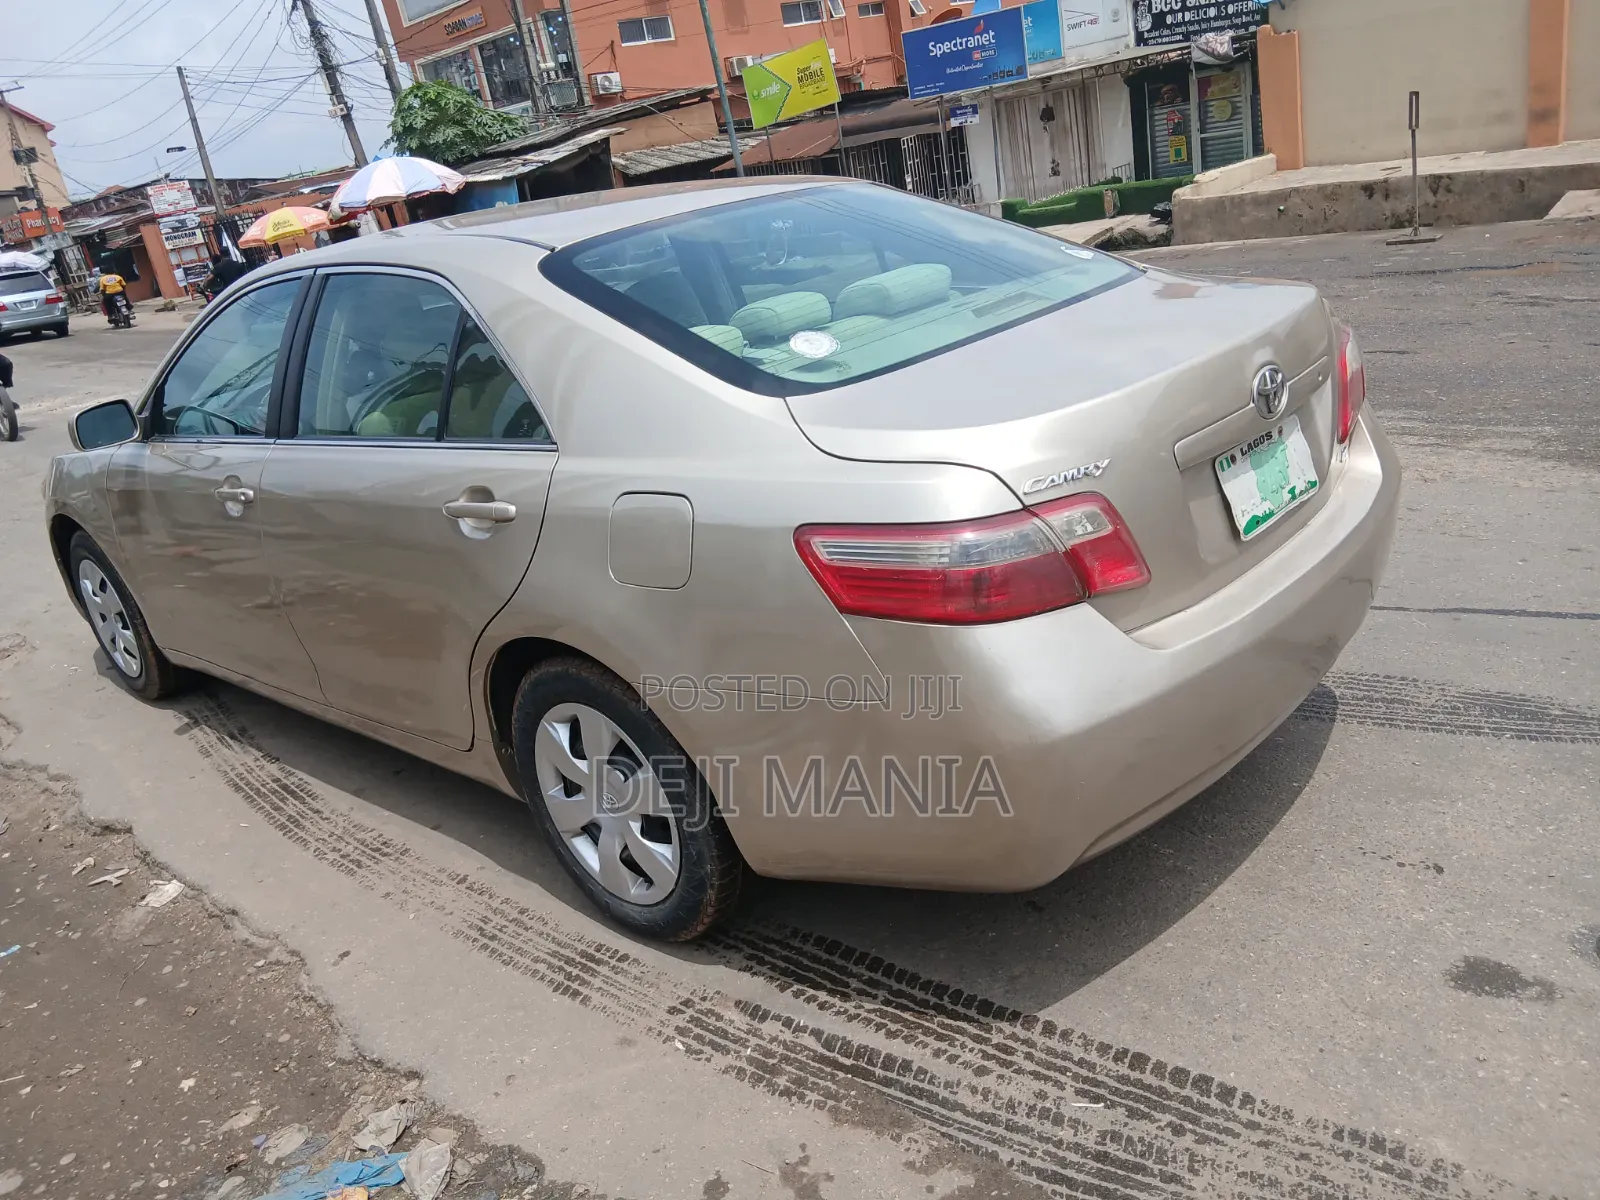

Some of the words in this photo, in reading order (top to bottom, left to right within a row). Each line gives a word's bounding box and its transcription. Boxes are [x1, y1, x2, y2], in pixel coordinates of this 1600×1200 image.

[1151, 0, 1182, 13] BCC
[1166, 12, 1183, 24] OUR
[1227, 1, 1266, 15] OFFERIN
[1067, 20, 1087, 31] SWIFT
[928, 29, 996, 58] Spectranet
[981, 48, 995, 58] MORE
[797, 67, 824, 84] MOBILE
[760, 82, 780, 99] smile
[26, 216, 60, 229] Pharcy
[1240, 431, 1273, 457] LAGOS
[1022, 457, 1111, 496] CAMRY
